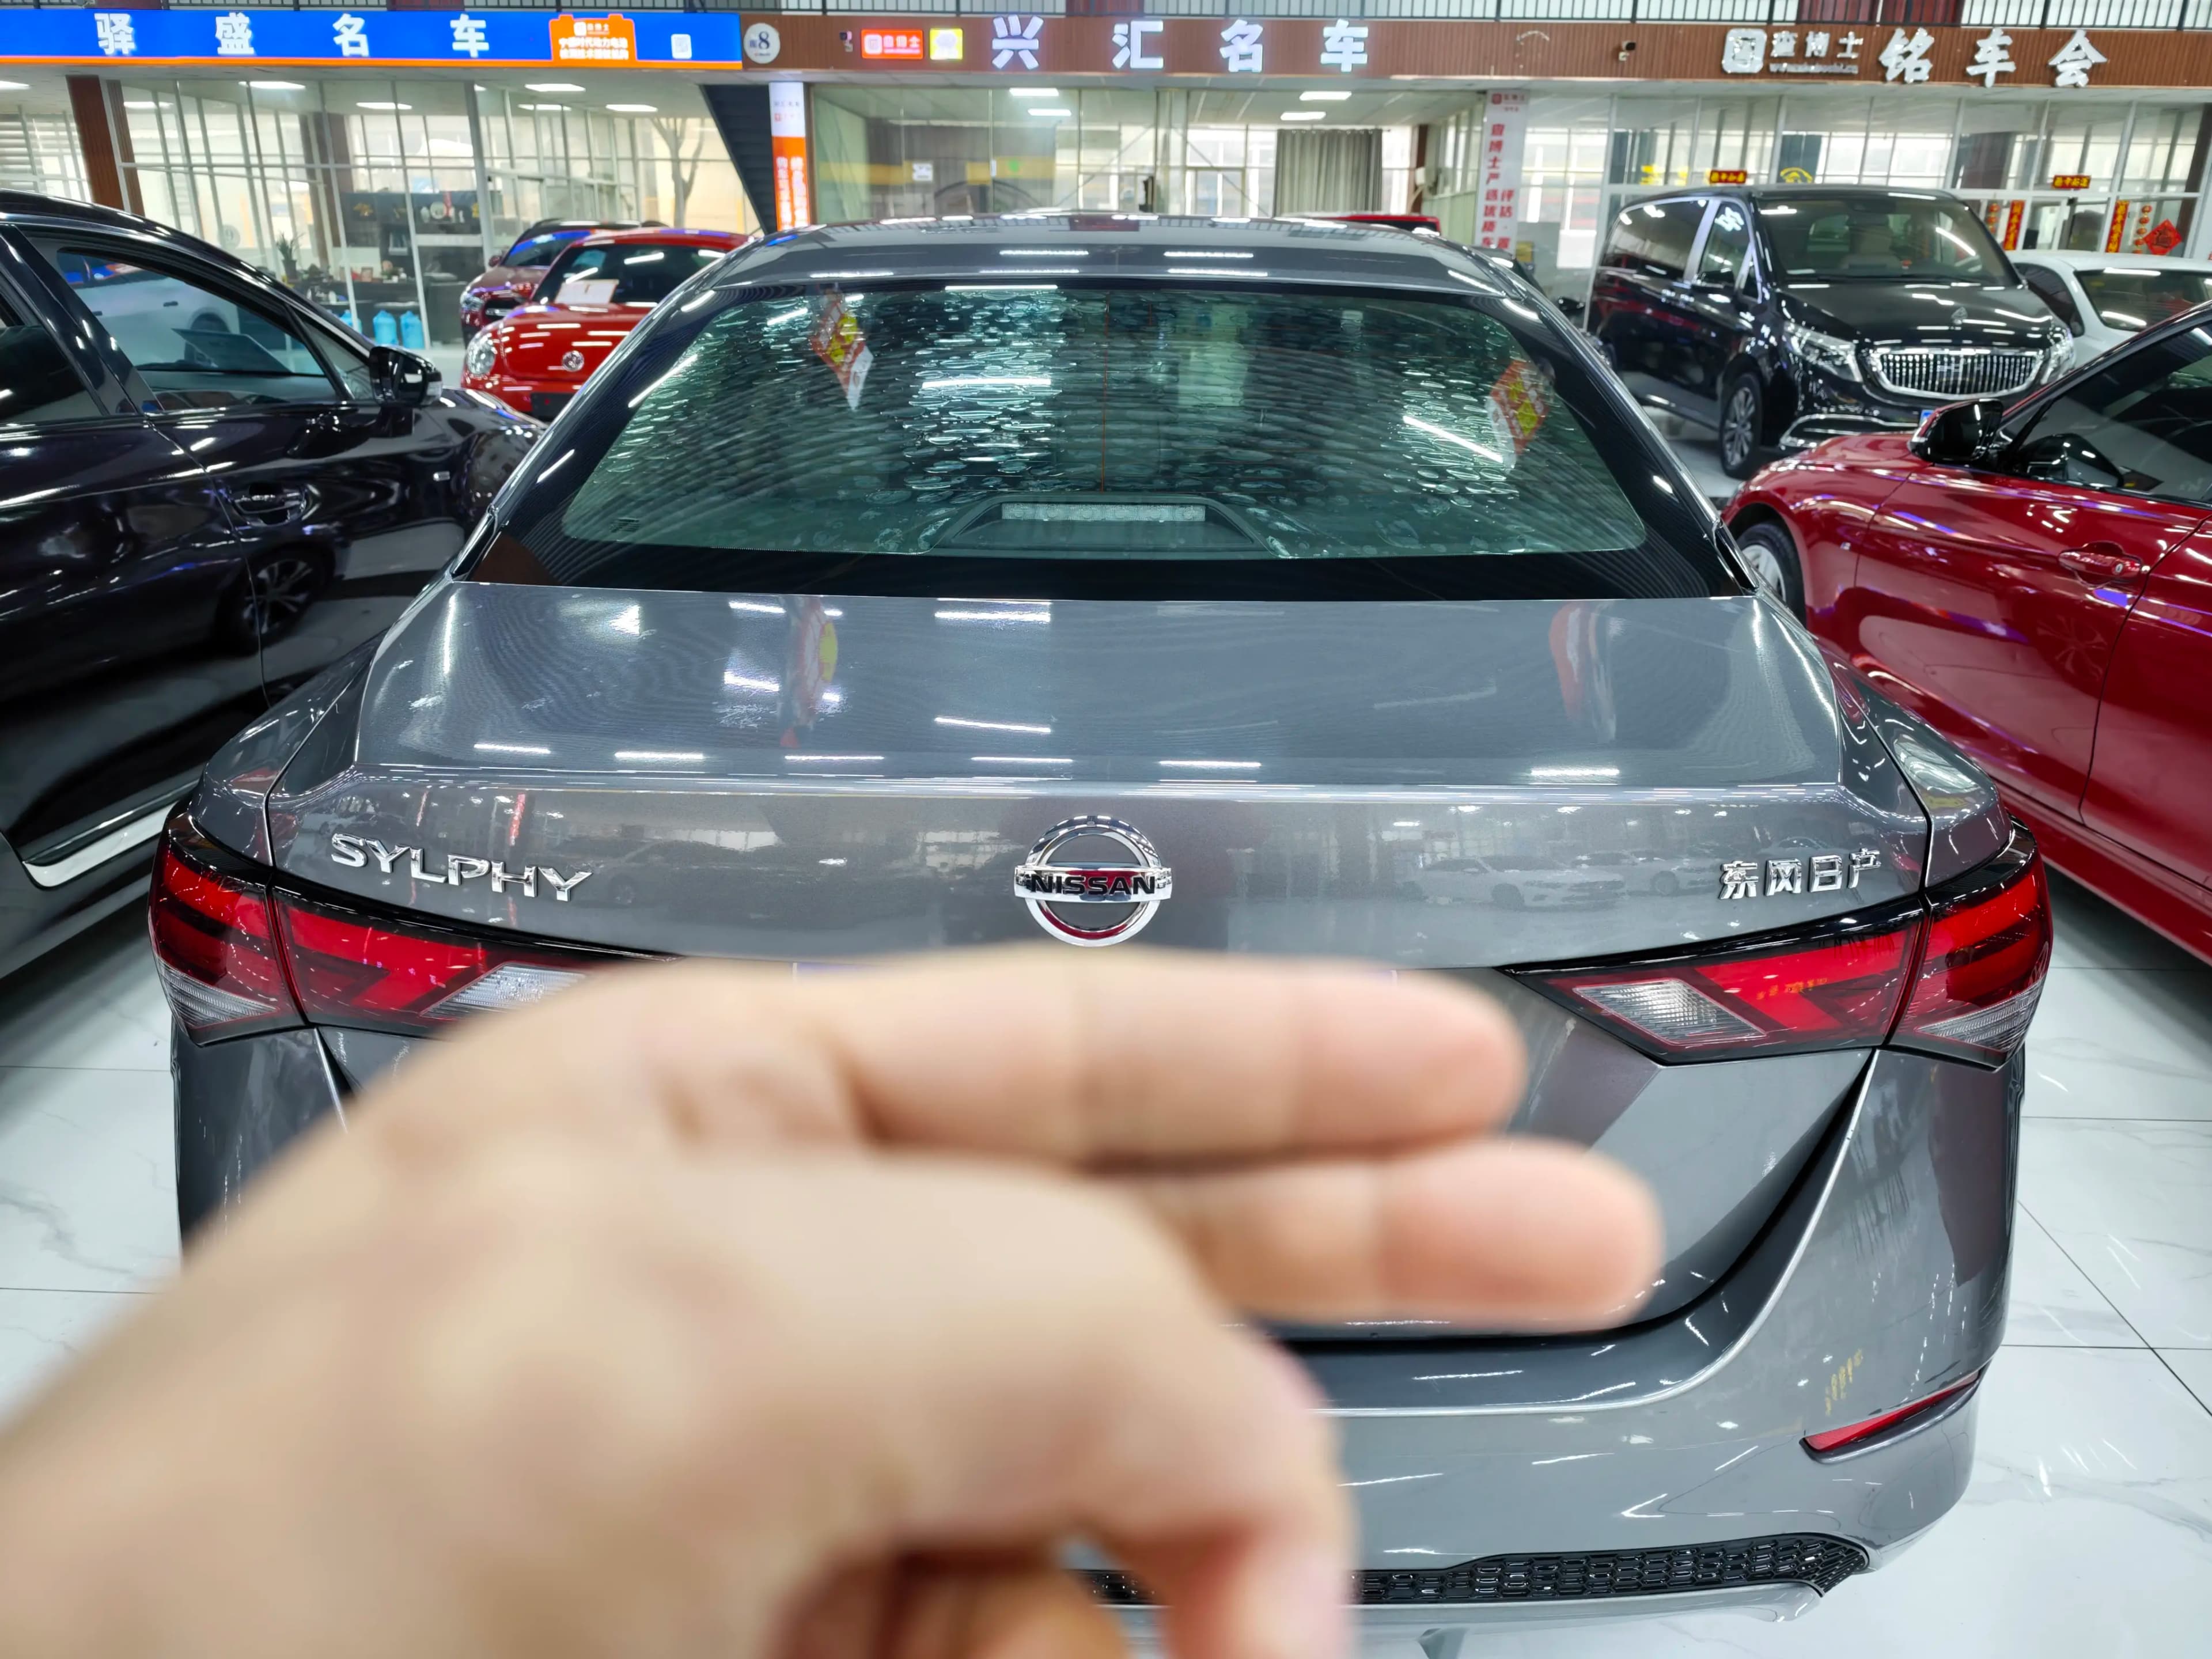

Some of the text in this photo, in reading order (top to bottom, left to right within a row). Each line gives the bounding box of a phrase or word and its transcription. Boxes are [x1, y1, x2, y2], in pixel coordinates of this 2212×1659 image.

[94, 12, 490, 58] 驿盛名车
[758, 31, 770, 50] 8
[992, 14, 1368, 73] 兴汇名车
[1878, 26, 2108, 88] 铭车会
[331, 832, 593, 903] SYLPHY
[1029, 873, 1156, 896] NISSAN
[1718, 847, 1882, 900] 东风日产
